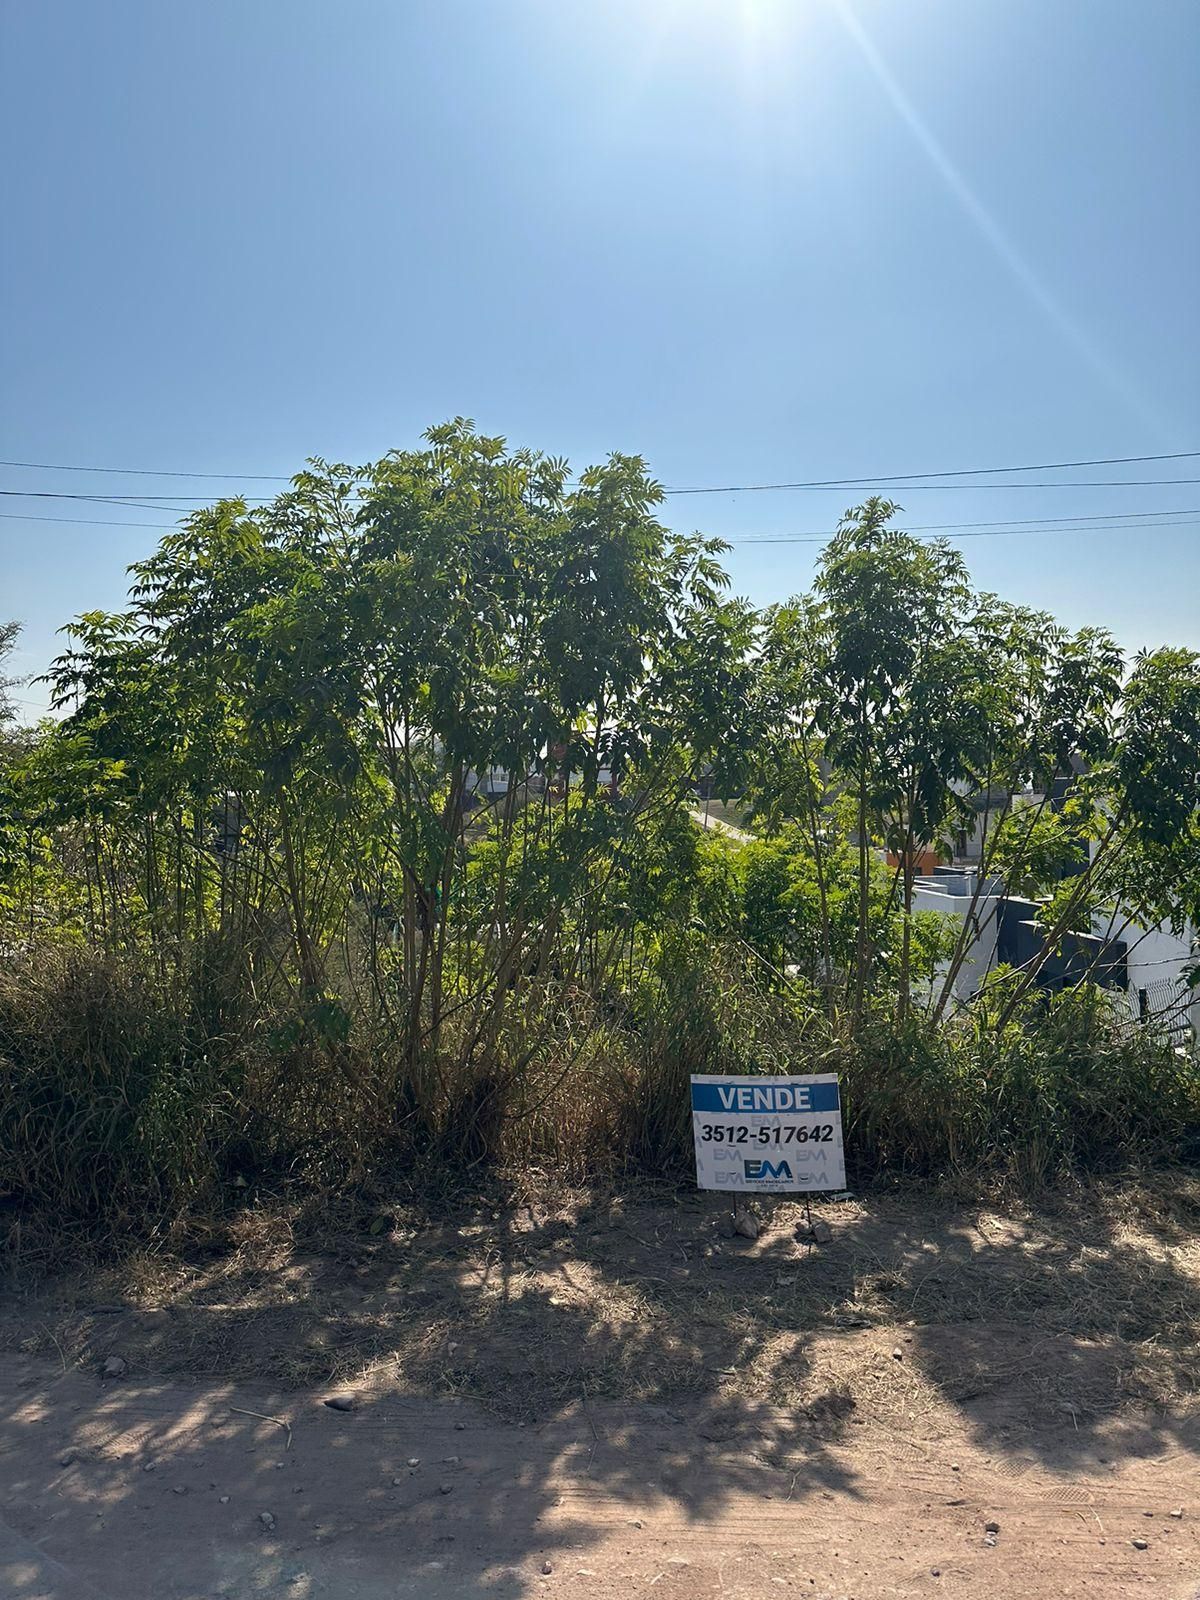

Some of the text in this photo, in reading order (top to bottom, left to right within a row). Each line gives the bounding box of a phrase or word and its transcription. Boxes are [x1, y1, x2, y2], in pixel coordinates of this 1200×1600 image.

[717, 1087, 811, 1110] VENDE
[701, 1125, 834, 1144] 3512-517642
[713, 1149, 743, 1161] EM
[796, 1149, 827, 1162] EM
[744, 1159, 793, 1178] EM
